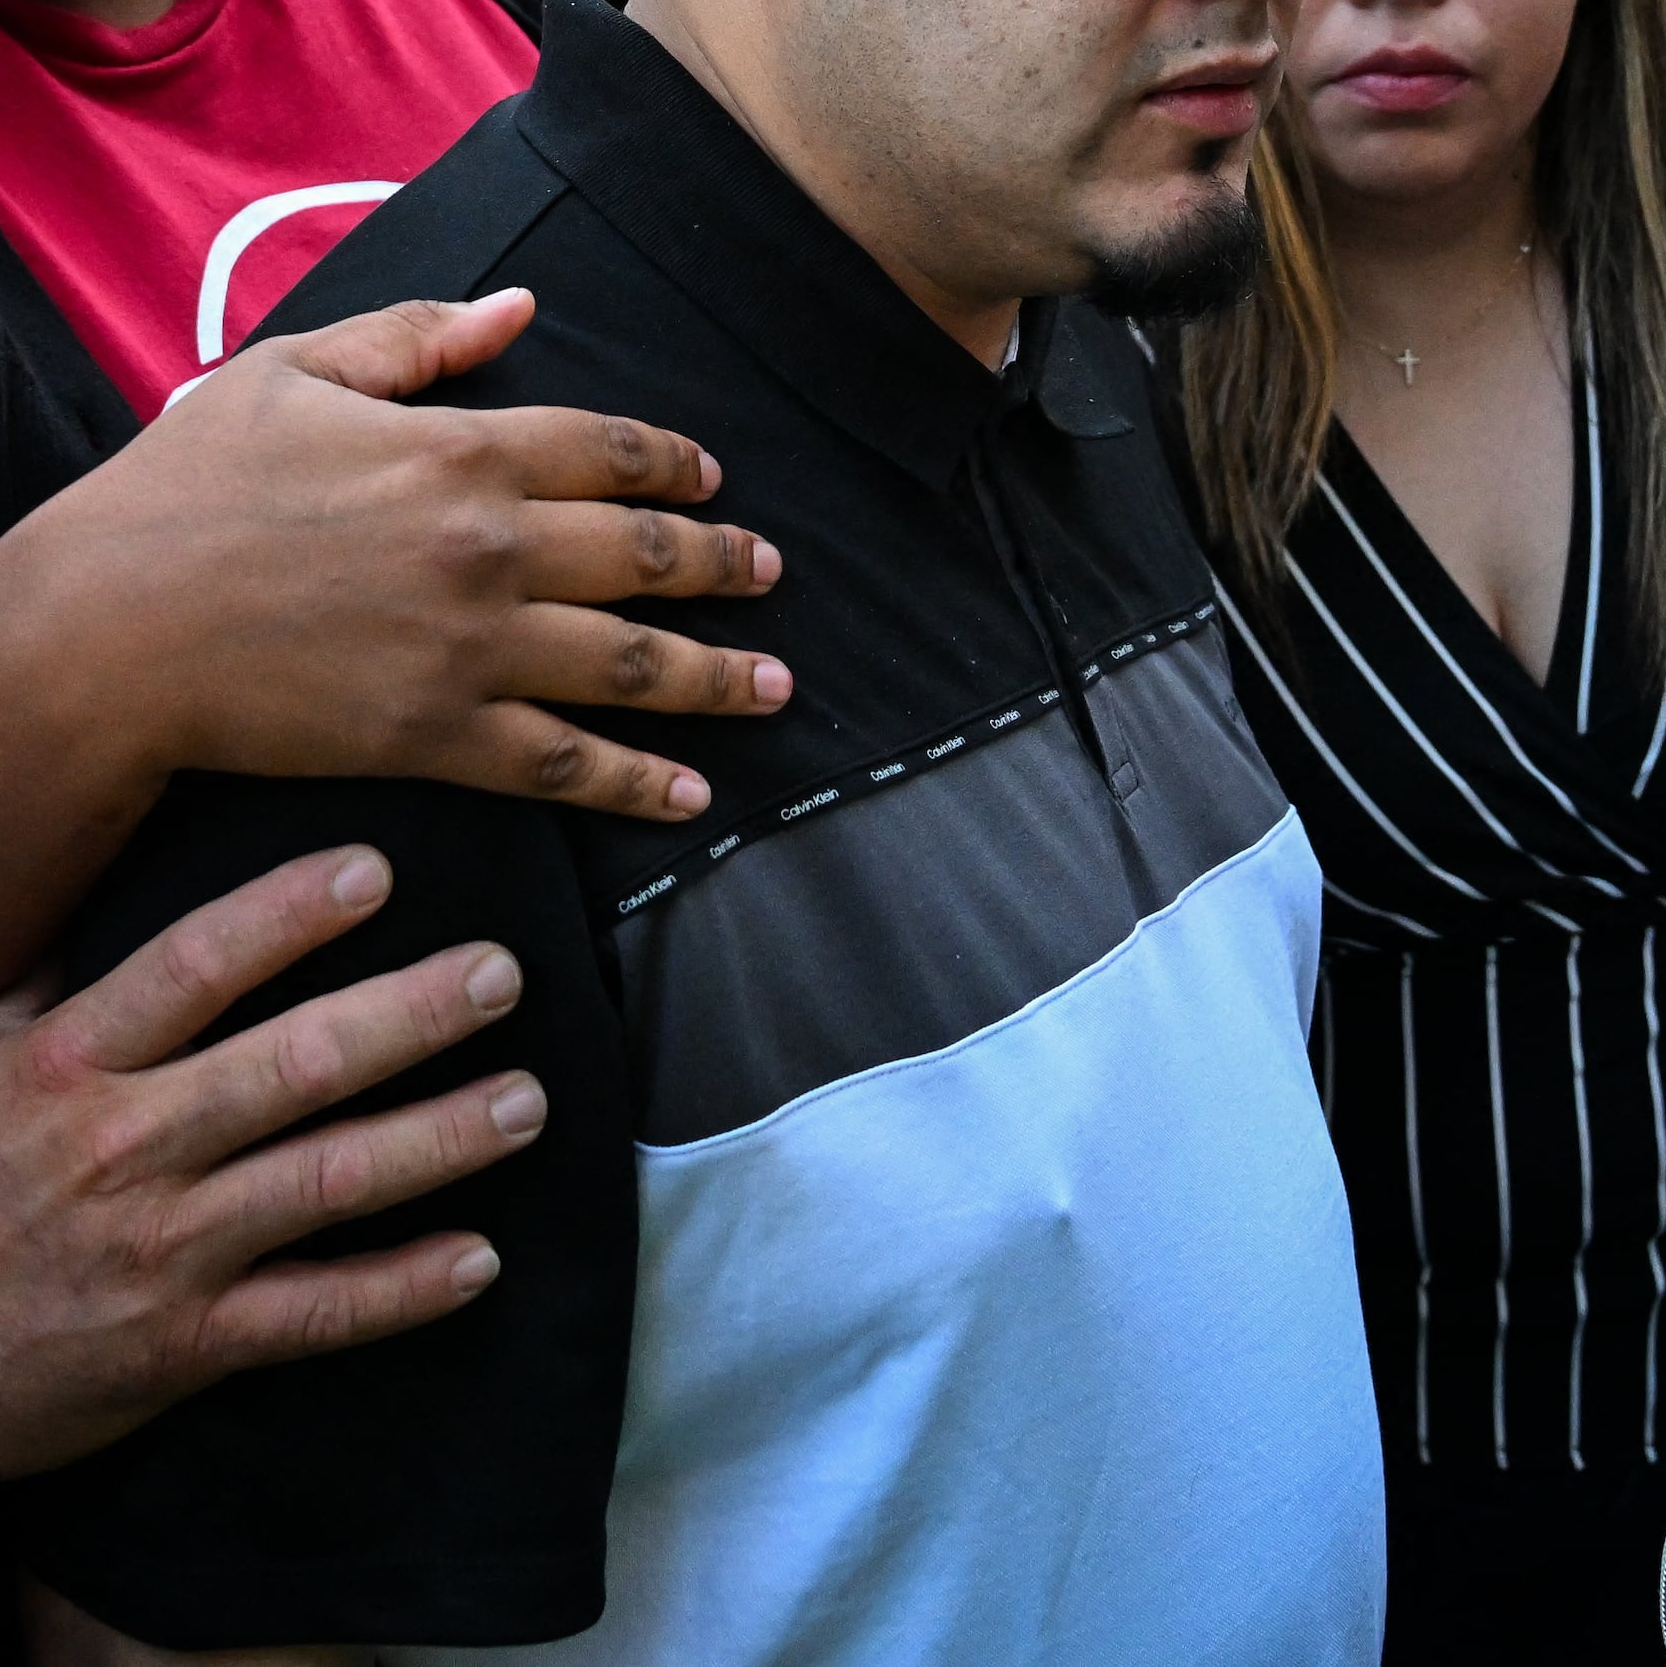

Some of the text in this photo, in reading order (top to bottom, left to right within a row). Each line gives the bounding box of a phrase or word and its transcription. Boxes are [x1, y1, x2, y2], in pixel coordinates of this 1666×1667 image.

[780, 787, 840, 821] Calvin Klein
[618, 873, 678, 914] Calvin Klein
